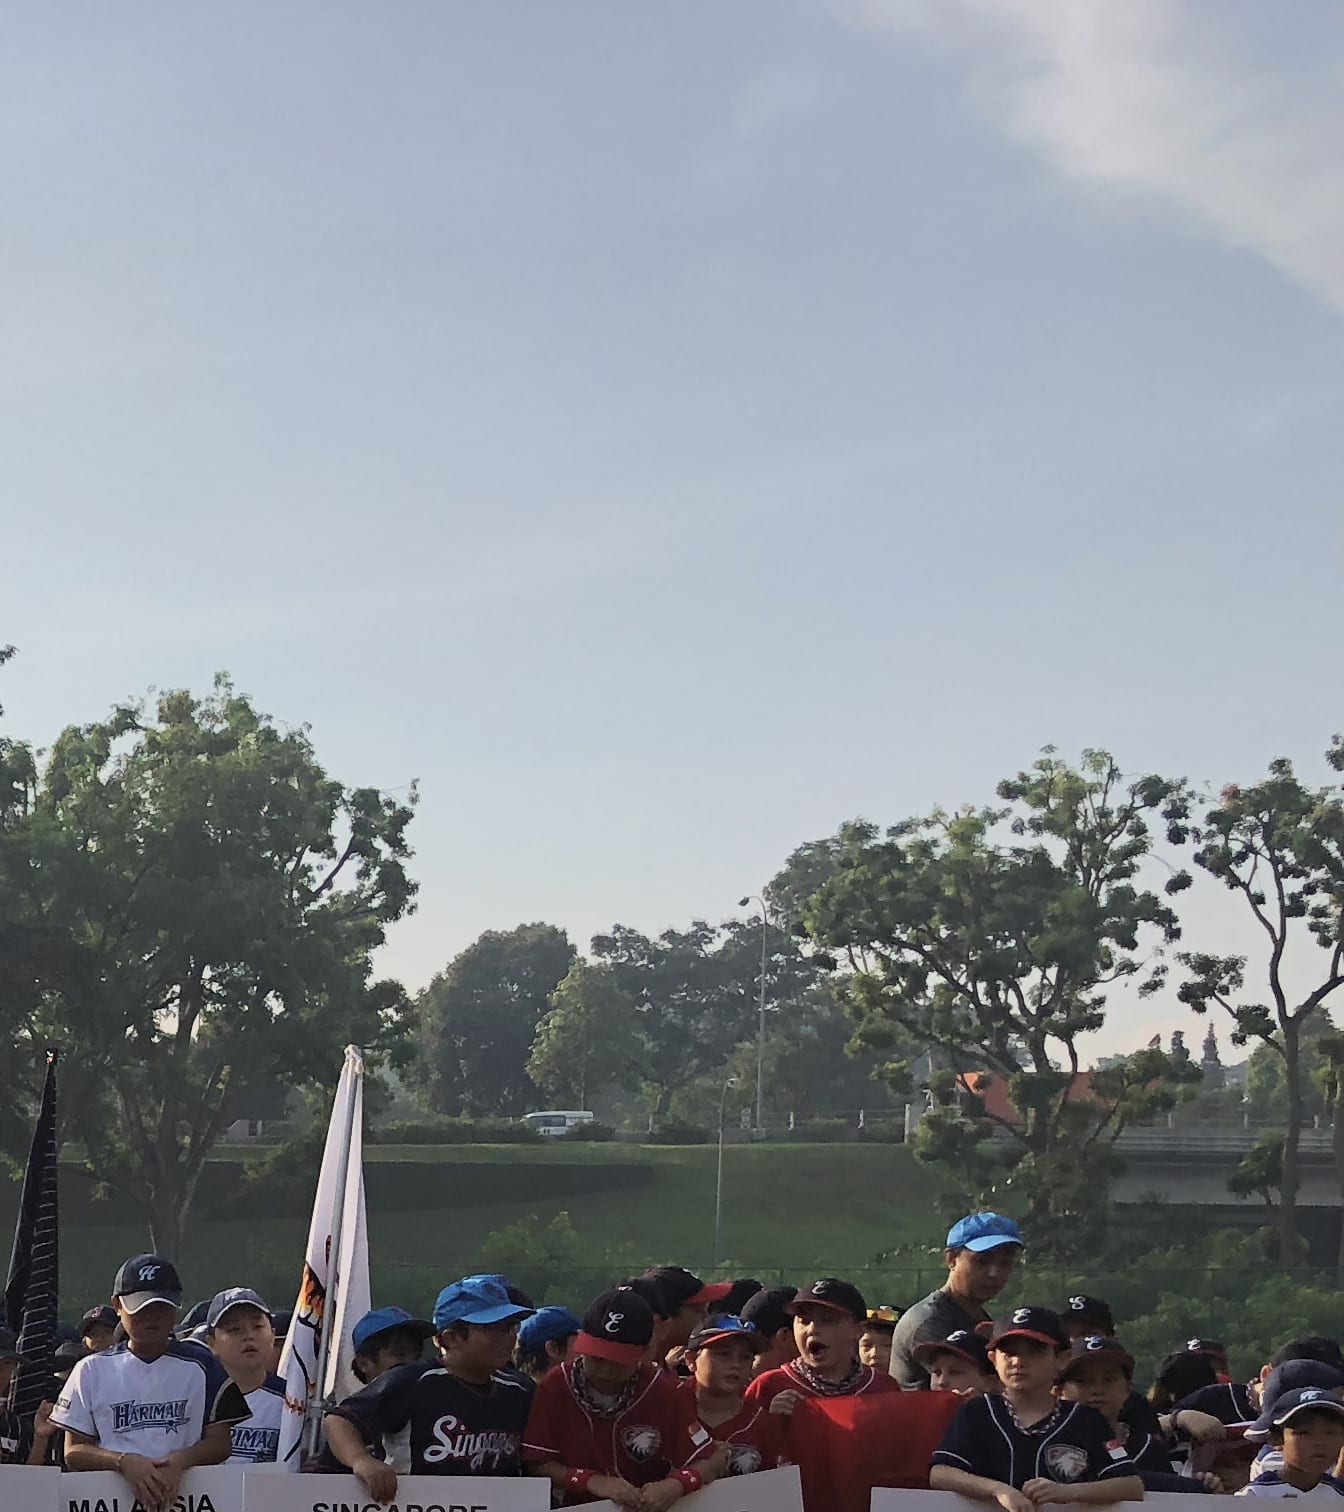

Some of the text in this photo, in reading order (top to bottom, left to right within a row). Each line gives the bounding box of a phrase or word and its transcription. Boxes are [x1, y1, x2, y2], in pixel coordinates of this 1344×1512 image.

[1068, 1295, 1087, 1311] S
[604, 1311, 625, 1333] E
[1012, 1307, 1032, 1324] E
[111, 1399, 190, 1432] HARIMAU
